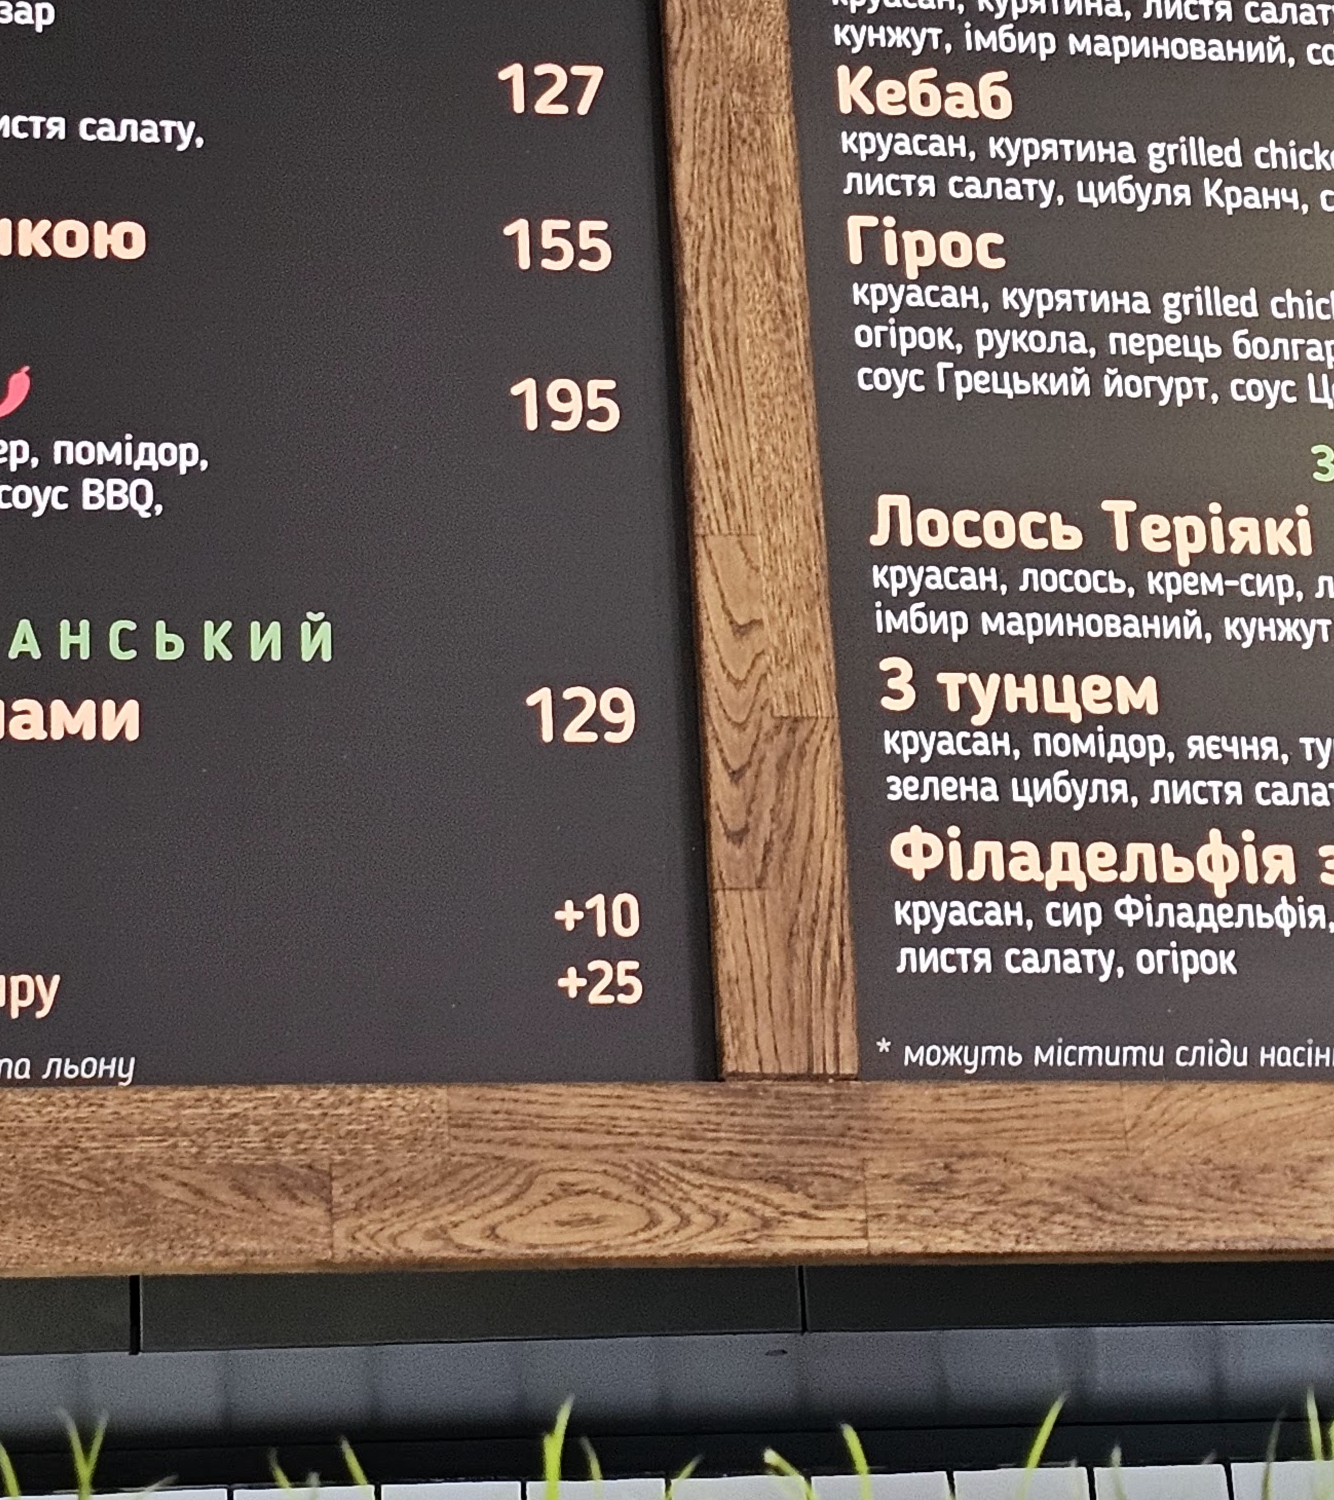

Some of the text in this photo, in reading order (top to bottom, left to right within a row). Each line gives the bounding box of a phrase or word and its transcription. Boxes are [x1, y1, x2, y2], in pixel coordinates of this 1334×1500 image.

[496, 61, 605, 117] 127
[835, 63, 1014, 121] Кебаб
[841, 170, 937, 199] листя
[946, 174, 1065, 210] салату,
[1075, 173, 1193, 214] цибуля
[1202, 176, 1310, 217] Кранч,
[501, 217, 613, 273] 155
[845, 213, 1008, 281] Гірос
[508, 376, 622, 433] 195
[856, 366, 927, 400] соус
[935, 360, 1092, 402] Грецький
[1102, 366, 1220, 409] йогурт,
[1229, 377, 1298, 411] соус
[52, 432, 210, 477] помідор,
[868, 492, 1314, 569] Лосось Теріякі
[524, 684, 637, 745] 129
[877, 655, 1160, 728] З тунцем
[885, 774, 1001, 803] зелена
[1010, 768, 1140, 813] цибуля,
[1148, 778, 1244, 807] листя
[888, 823, 1298, 900] Філадельфія
[553, 891, 641, 939] +10
[556, 958, 644, 1006] +25
[40, 1055, 138, 1090] льону
[902, 1043, 1024, 1076] можуть
[1032, 1037, 1166, 1068] містити
[1174, 1036, 1249, 1069] сліди
